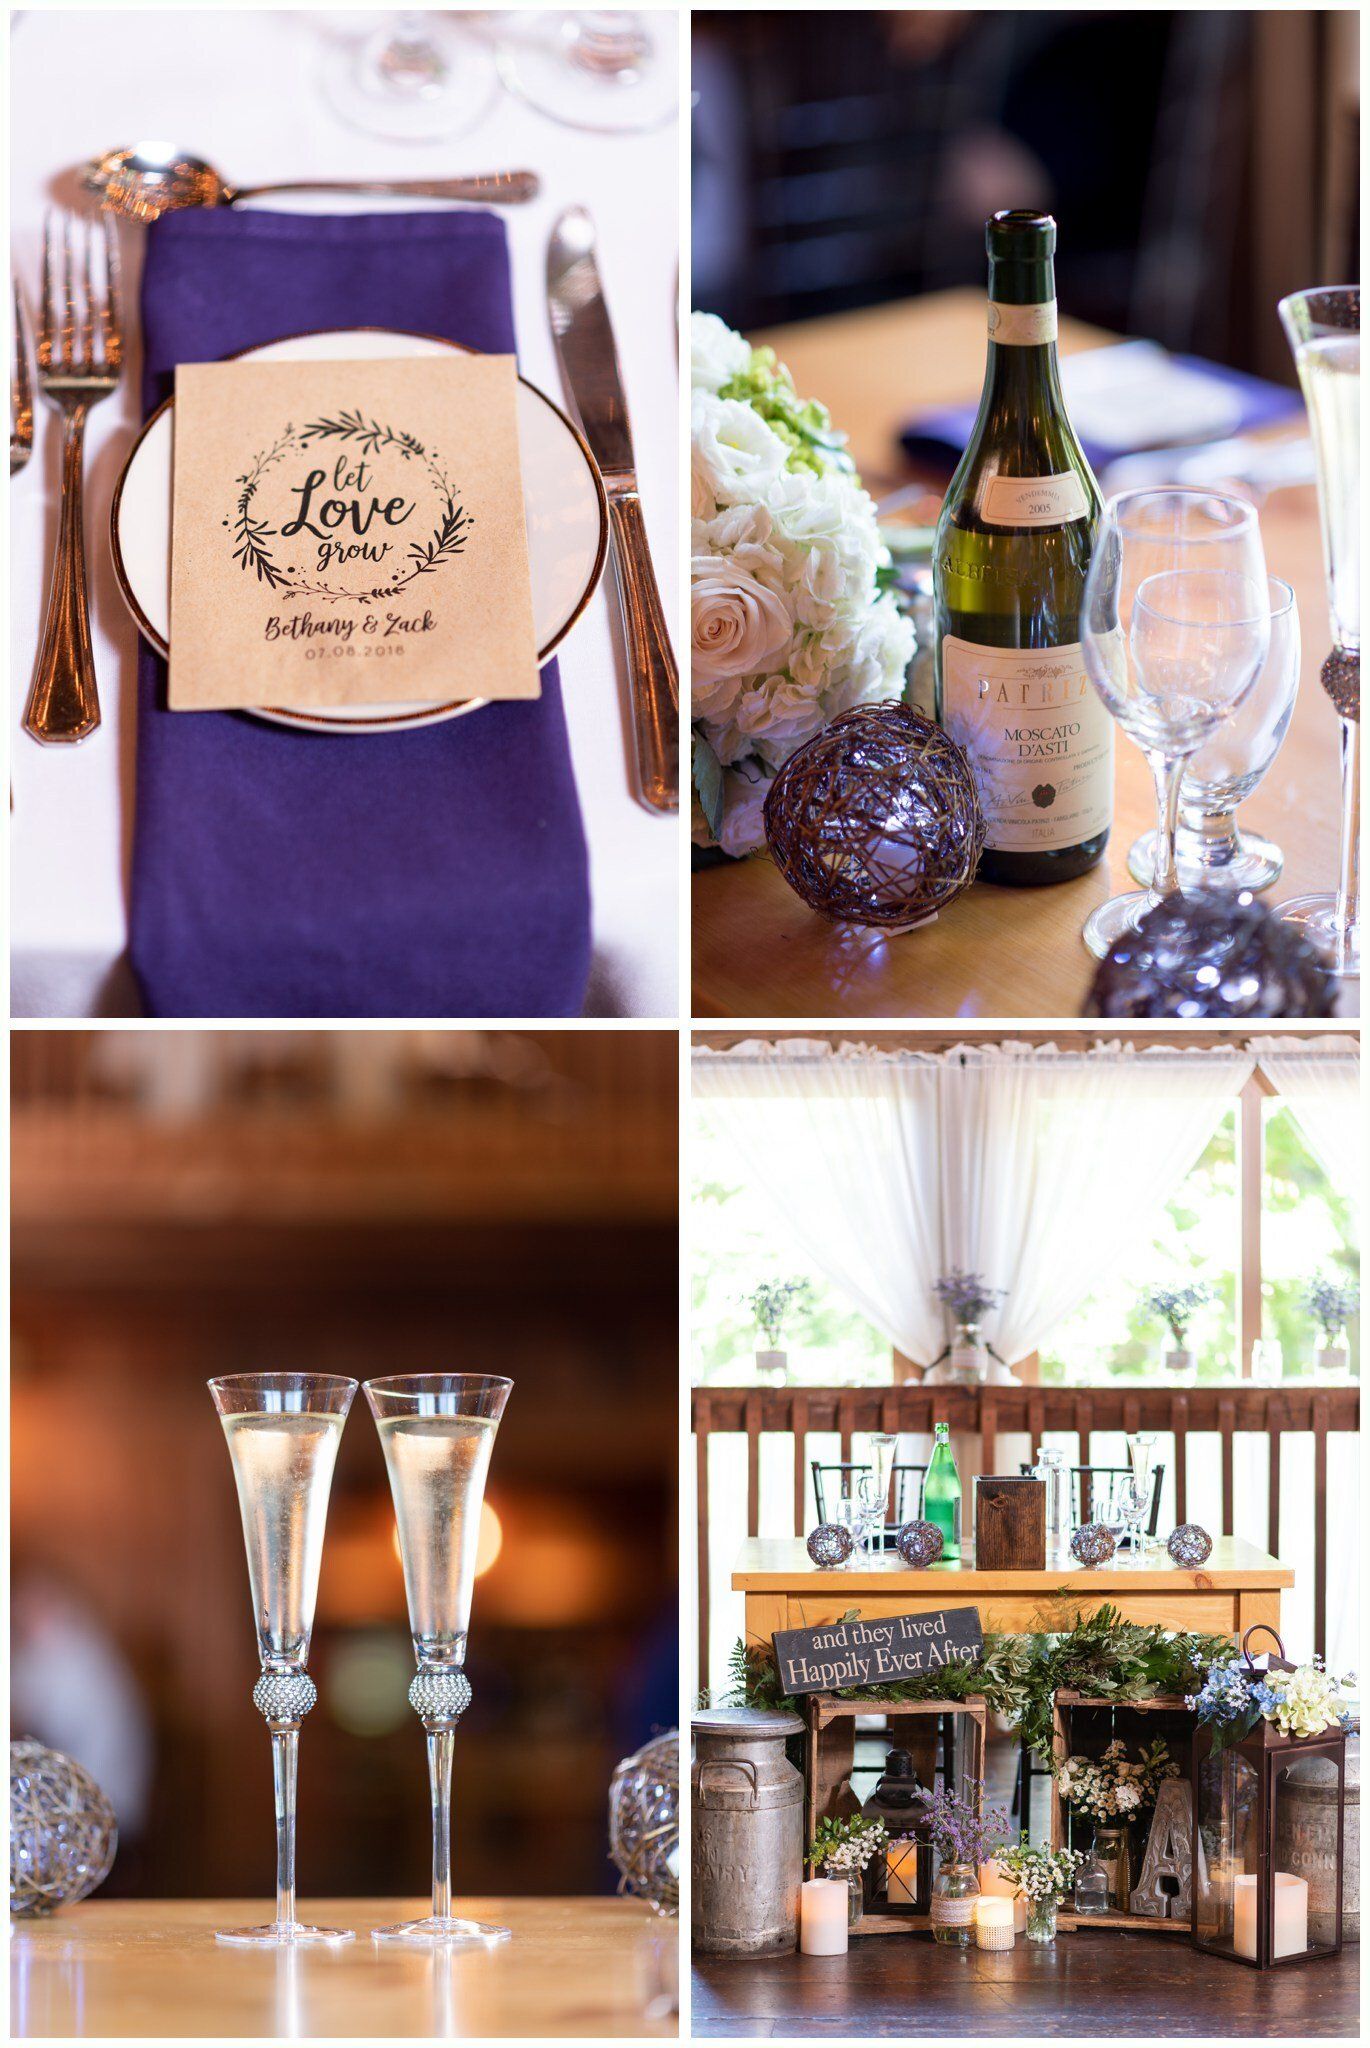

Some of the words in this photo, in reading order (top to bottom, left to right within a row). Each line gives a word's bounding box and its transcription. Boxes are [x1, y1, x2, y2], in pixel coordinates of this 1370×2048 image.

[333, 455, 372, 492] let
[281, 469, 416, 540] Love
[1028, 504, 1051, 514] 2005
[316, 541, 394, 572] grow
[264, 611, 358, 642] Bethany
[362, 614, 379, 635] &
[383, 609, 438, 637] Zack
[977, 674, 1088, 704] PATRIZ
[1004, 722, 1081, 742] MOSCATO
[1018, 740, 1069, 757] D'ASTI
[1032, 828, 1055, 839] ITALIA
[812, 1625, 849, 1650] and
[852, 1623, 895, 1647] they
[900, 1613, 948, 1639] lived
[786, 1652, 871, 1688] Happily
[874, 1647, 923, 1675] Ever
[927, 1639, 981, 1668] After
